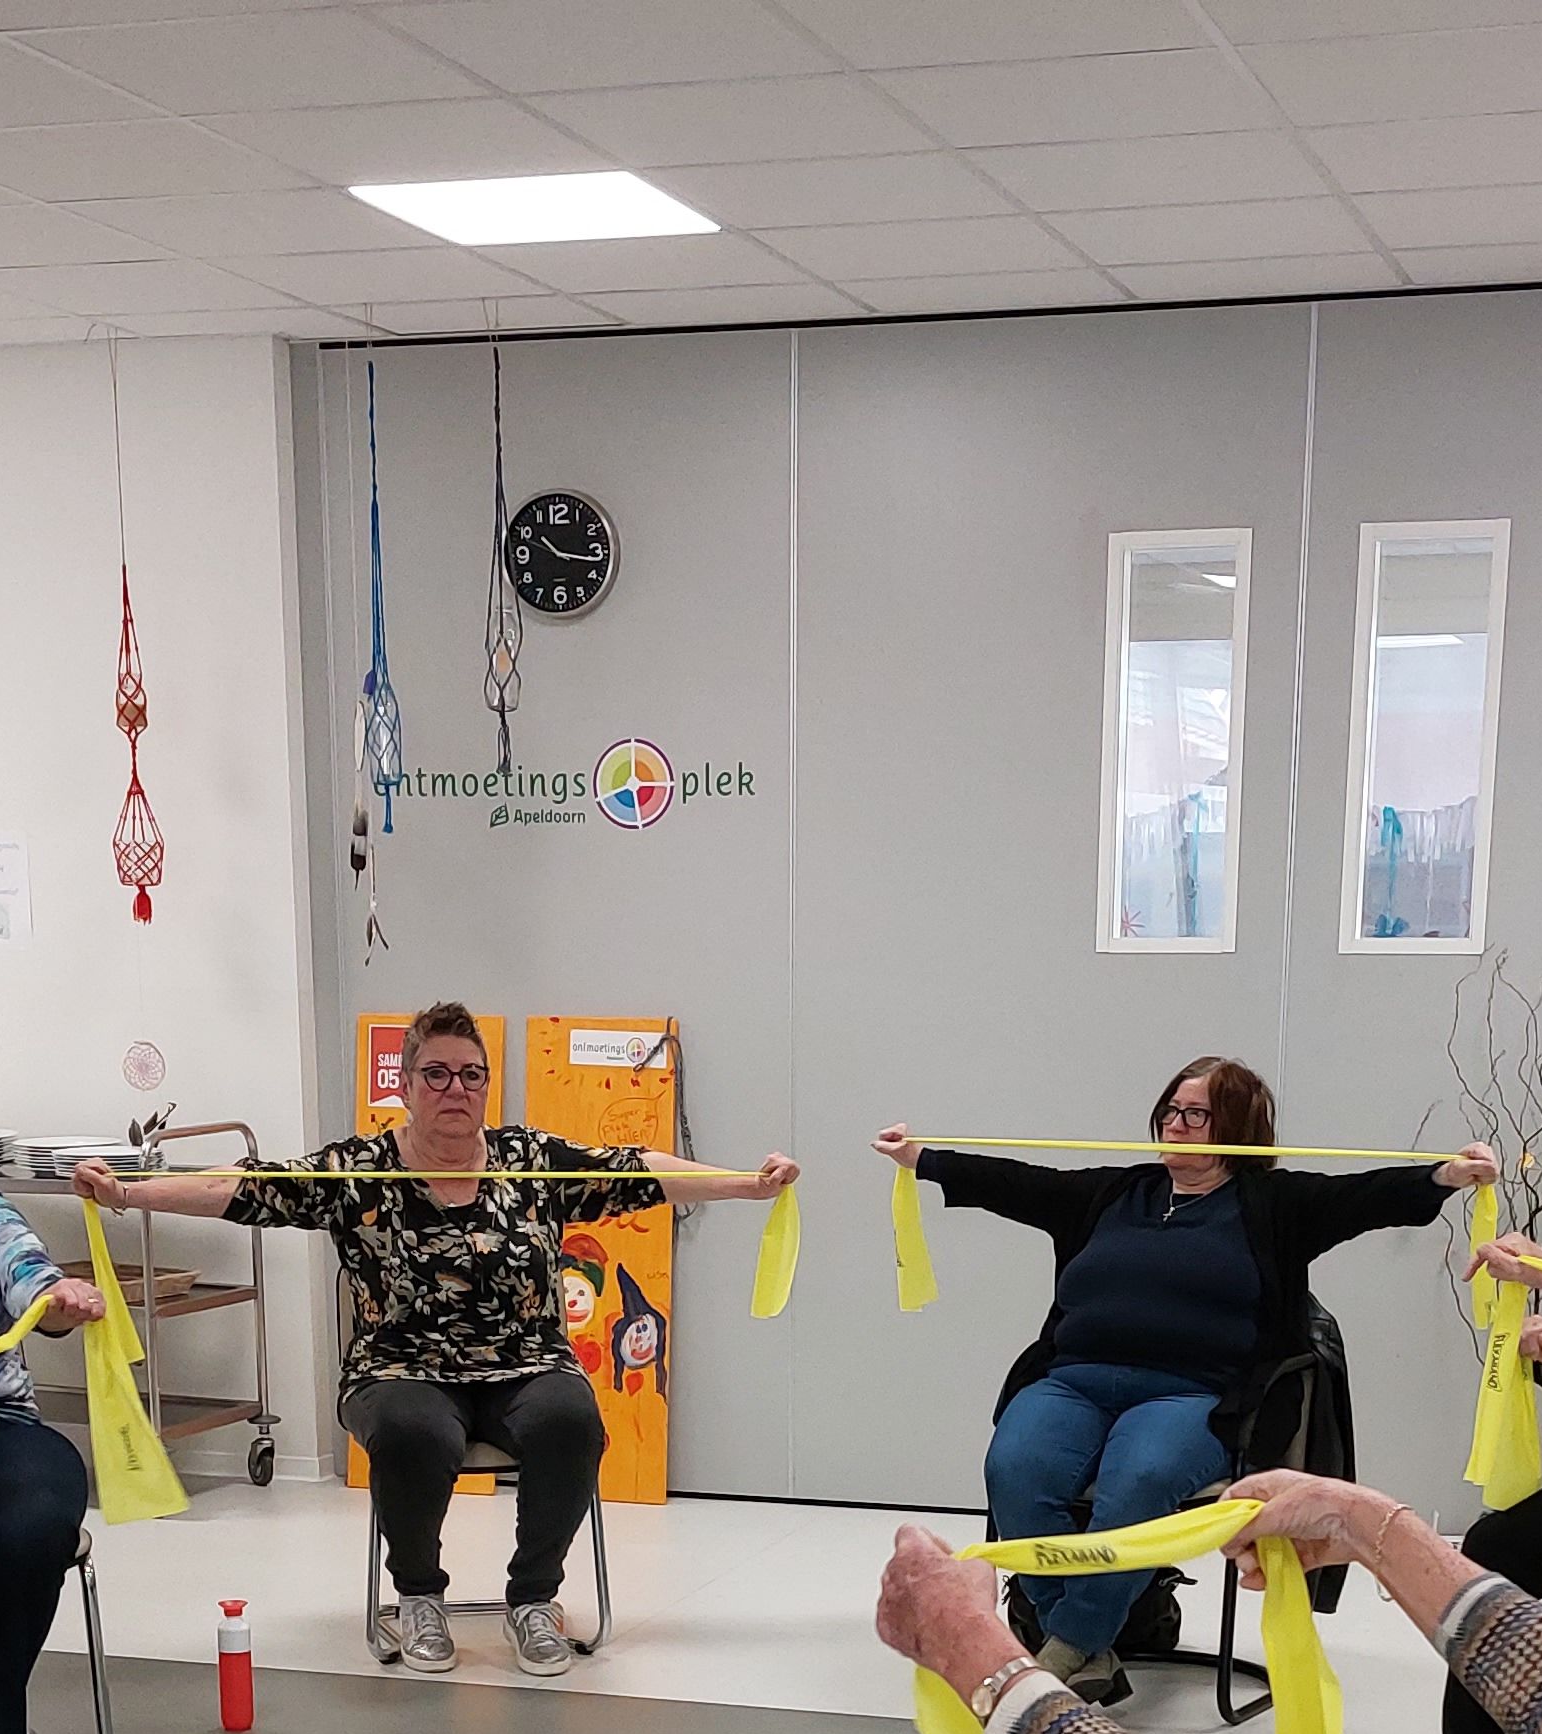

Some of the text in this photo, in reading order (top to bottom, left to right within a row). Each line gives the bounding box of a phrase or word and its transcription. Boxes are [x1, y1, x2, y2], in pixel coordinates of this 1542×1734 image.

[548, 503, 571, 525] 12
[520, 525, 533, 540] 10
[586, 523, 598, 536] 2
[515, 545, 530, 565] 9
[588, 542, 604, 562] 3
[522, 571, 533, 584] 8
[587, 569, 598, 580] 4
[535, 587, 544, 602] 7
[553, 586, 567, 604] 6
[576, 586, 585, 598] 5
[682, 762, 757, 804] plek
[513, 804, 587, 827] Apeldoorn
[377, 1053, 403, 1067] SAM
[377, 1069, 401, 1089] 05
